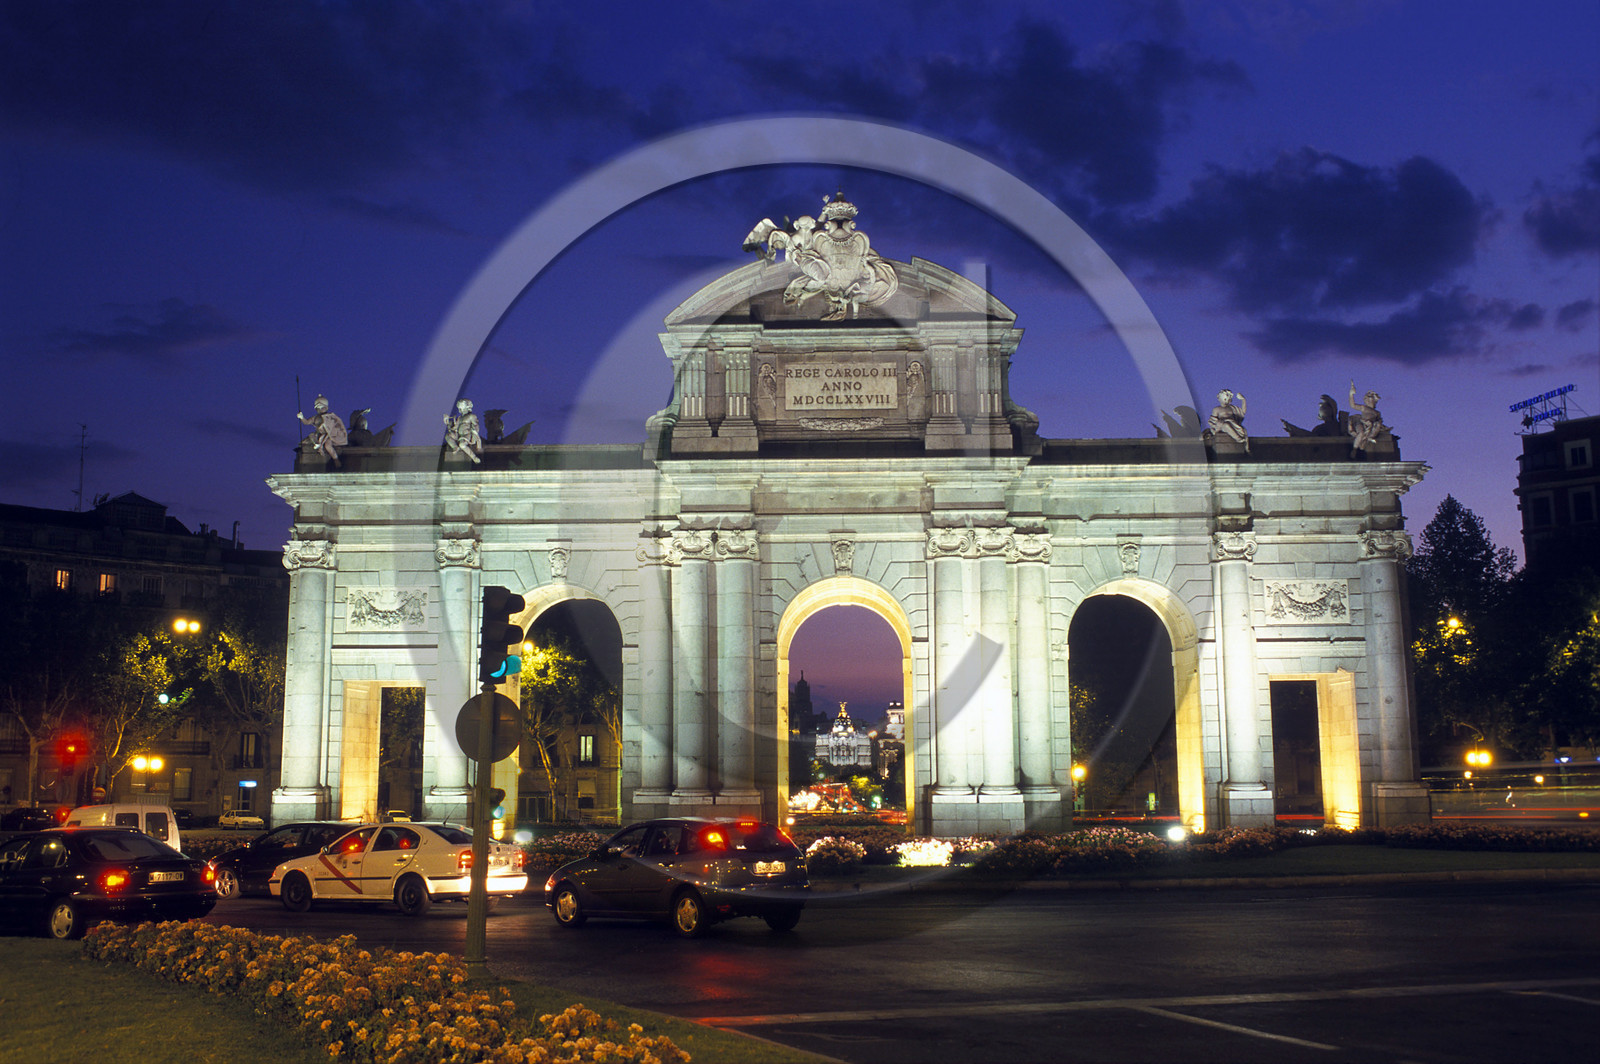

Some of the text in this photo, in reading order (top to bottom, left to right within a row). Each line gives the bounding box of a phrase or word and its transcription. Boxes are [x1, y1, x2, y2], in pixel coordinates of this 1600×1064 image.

[785, 367, 898, 378] REGE CAROLO III
[821, 381, 862, 391] ANNO
[792, 394, 891, 405] MDCCLXXVIII
[1509, 394, 1543, 412] SEGUROS
